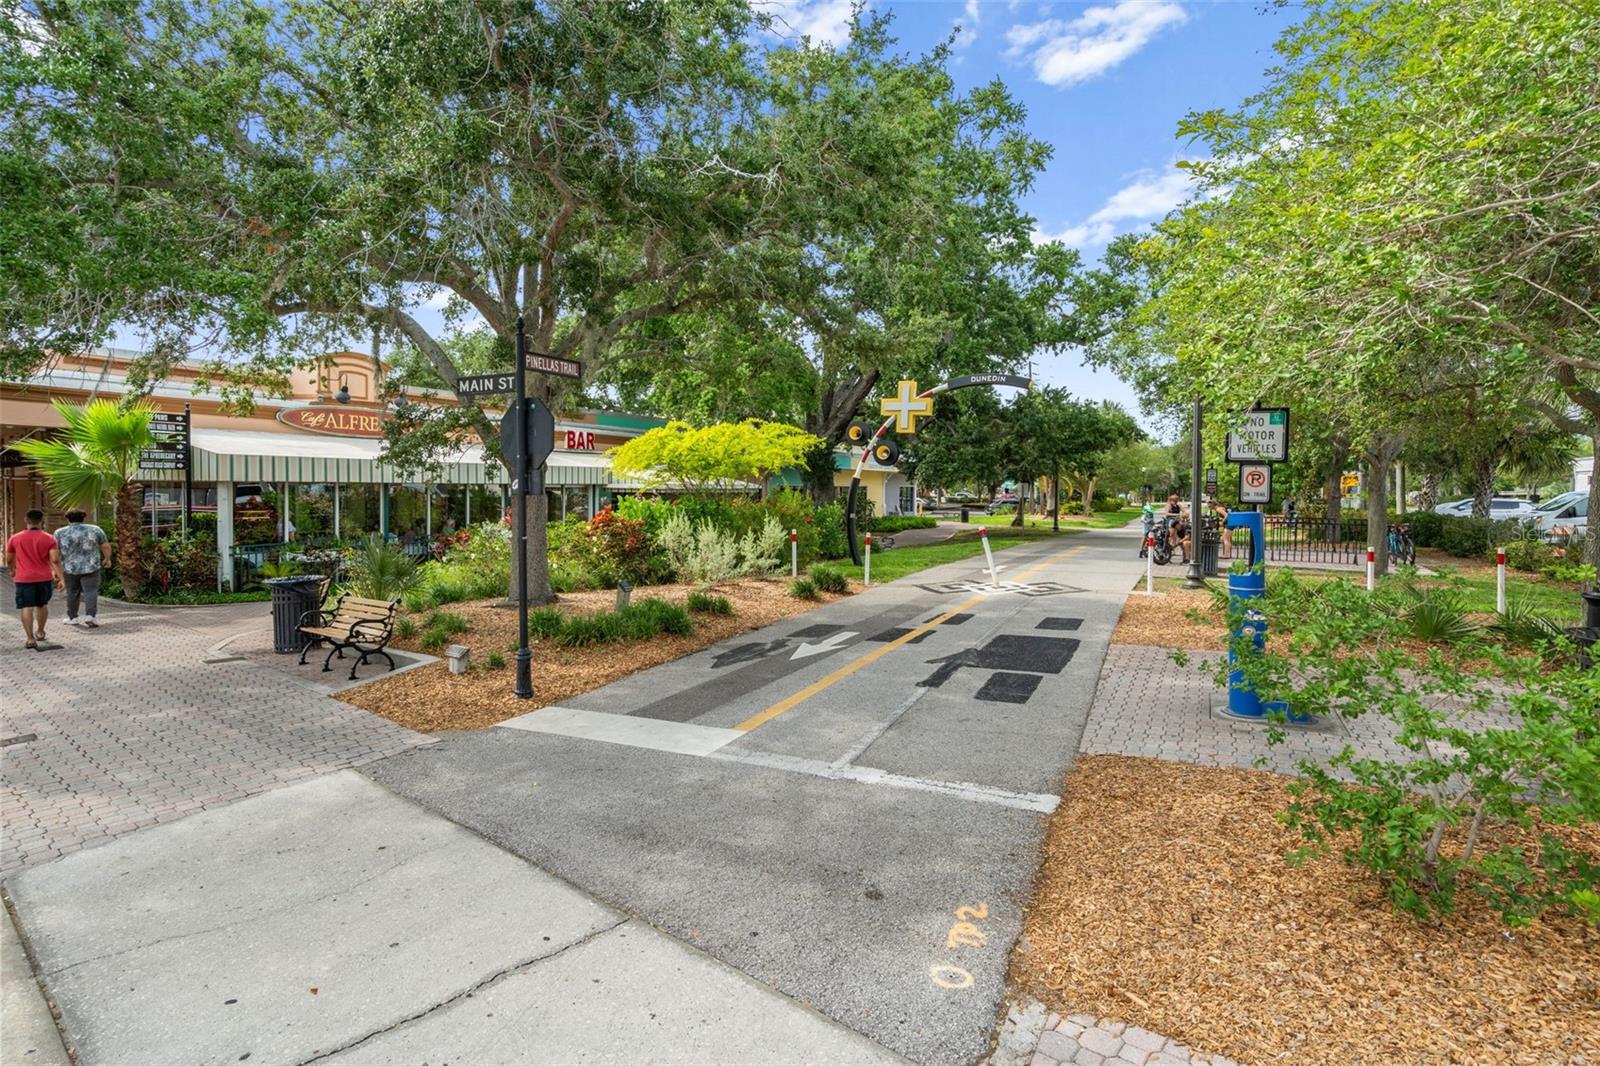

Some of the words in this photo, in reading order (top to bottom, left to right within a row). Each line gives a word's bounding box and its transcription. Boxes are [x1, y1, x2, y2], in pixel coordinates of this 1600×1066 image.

[525, 355, 560, 373] PINELLAS
[560, 362, 579, 376] TRAIL
[459, 378, 494, 393] MAIN
[498, 376, 515, 390] ST
[970, 375, 1007, 383] DUNEDIN
[325, 412, 384, 433] ALFRE
[1250, 417, 1265, 428] NO
[566, 430, 595, 450] BAR
[1237, 443, 1277, 454] VEHICLES
